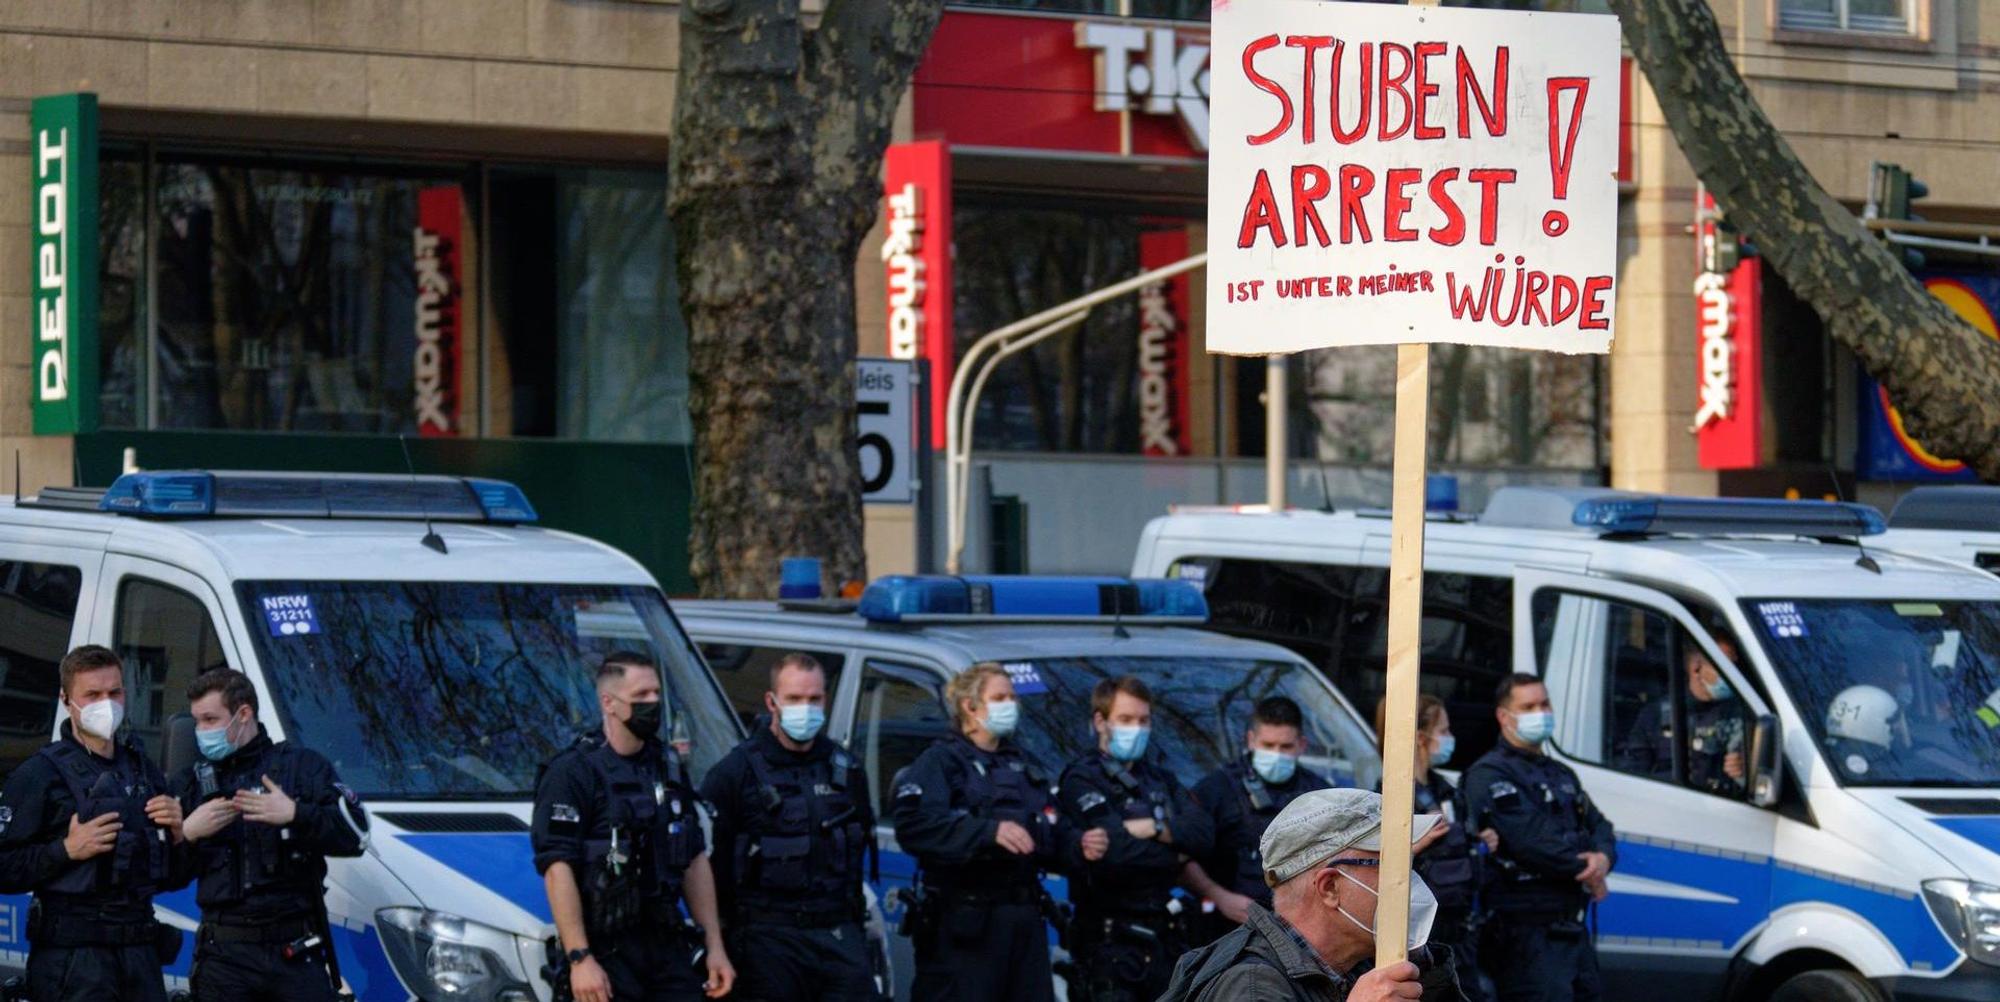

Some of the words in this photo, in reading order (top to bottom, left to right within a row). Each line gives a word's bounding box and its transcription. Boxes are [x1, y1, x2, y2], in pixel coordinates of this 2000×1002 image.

[1242, 33, 1510, 146] STUBEN
[1237, 164, 1517, 249] ARREST
[39, 126, 67, 402] DEPOT
[1226, 279, 1265, 304] IST
[1276, 275, 1353, 300] UNTER
[1446, 253, 1613, 330] WÜRDE
[857, 366, 895, 391] leis
[263, 595, 309, 610] NRW
[271, 608, 313, 622] 31211
[1758, 602, 1796, 615] NRW
